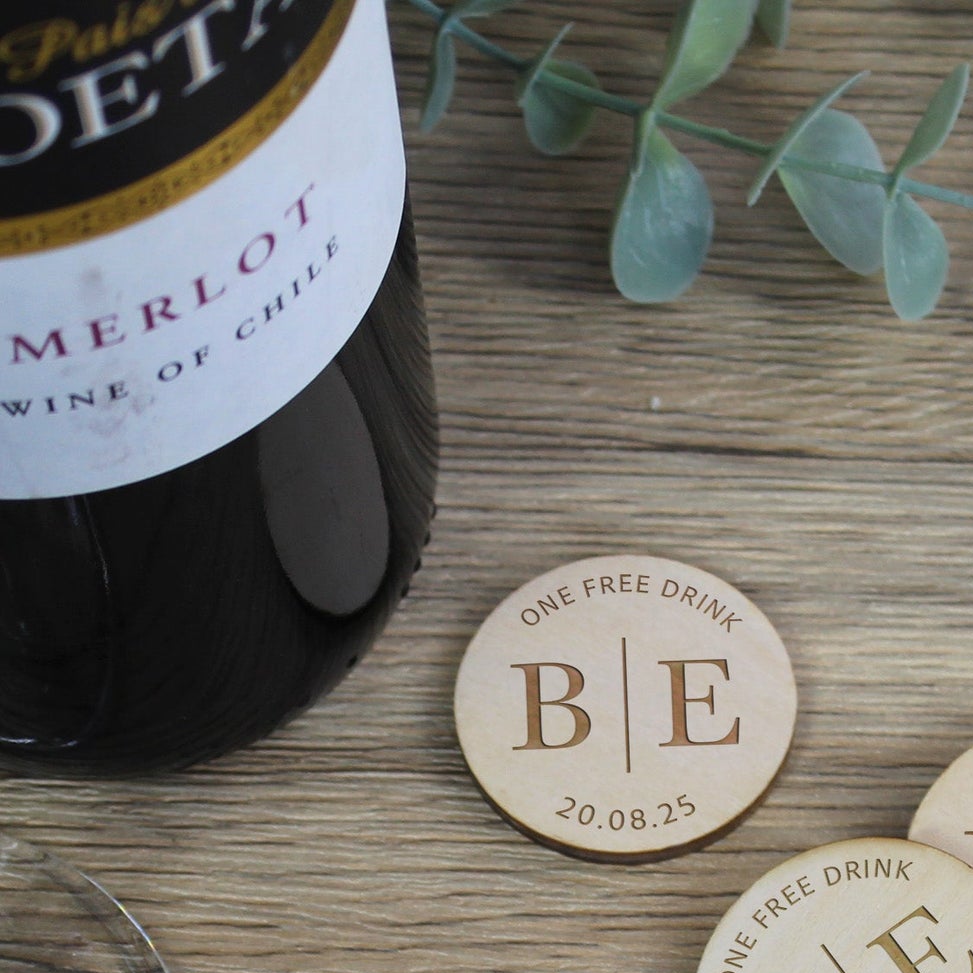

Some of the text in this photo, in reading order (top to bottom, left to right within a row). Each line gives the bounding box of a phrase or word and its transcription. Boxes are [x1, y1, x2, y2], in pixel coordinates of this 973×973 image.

[9, 183, 316, 365] MERLOT
[1, 234, 339, 417] WINE OF CHILE
[520, 573, 743, 633] ONE FREE DRINK
[510, 659, 740, 751] B E
[555, 794, 697, 831] 20.08.25
[751, 875, 816, 929] FREE
[823, 858, 914, 887] DRINK
